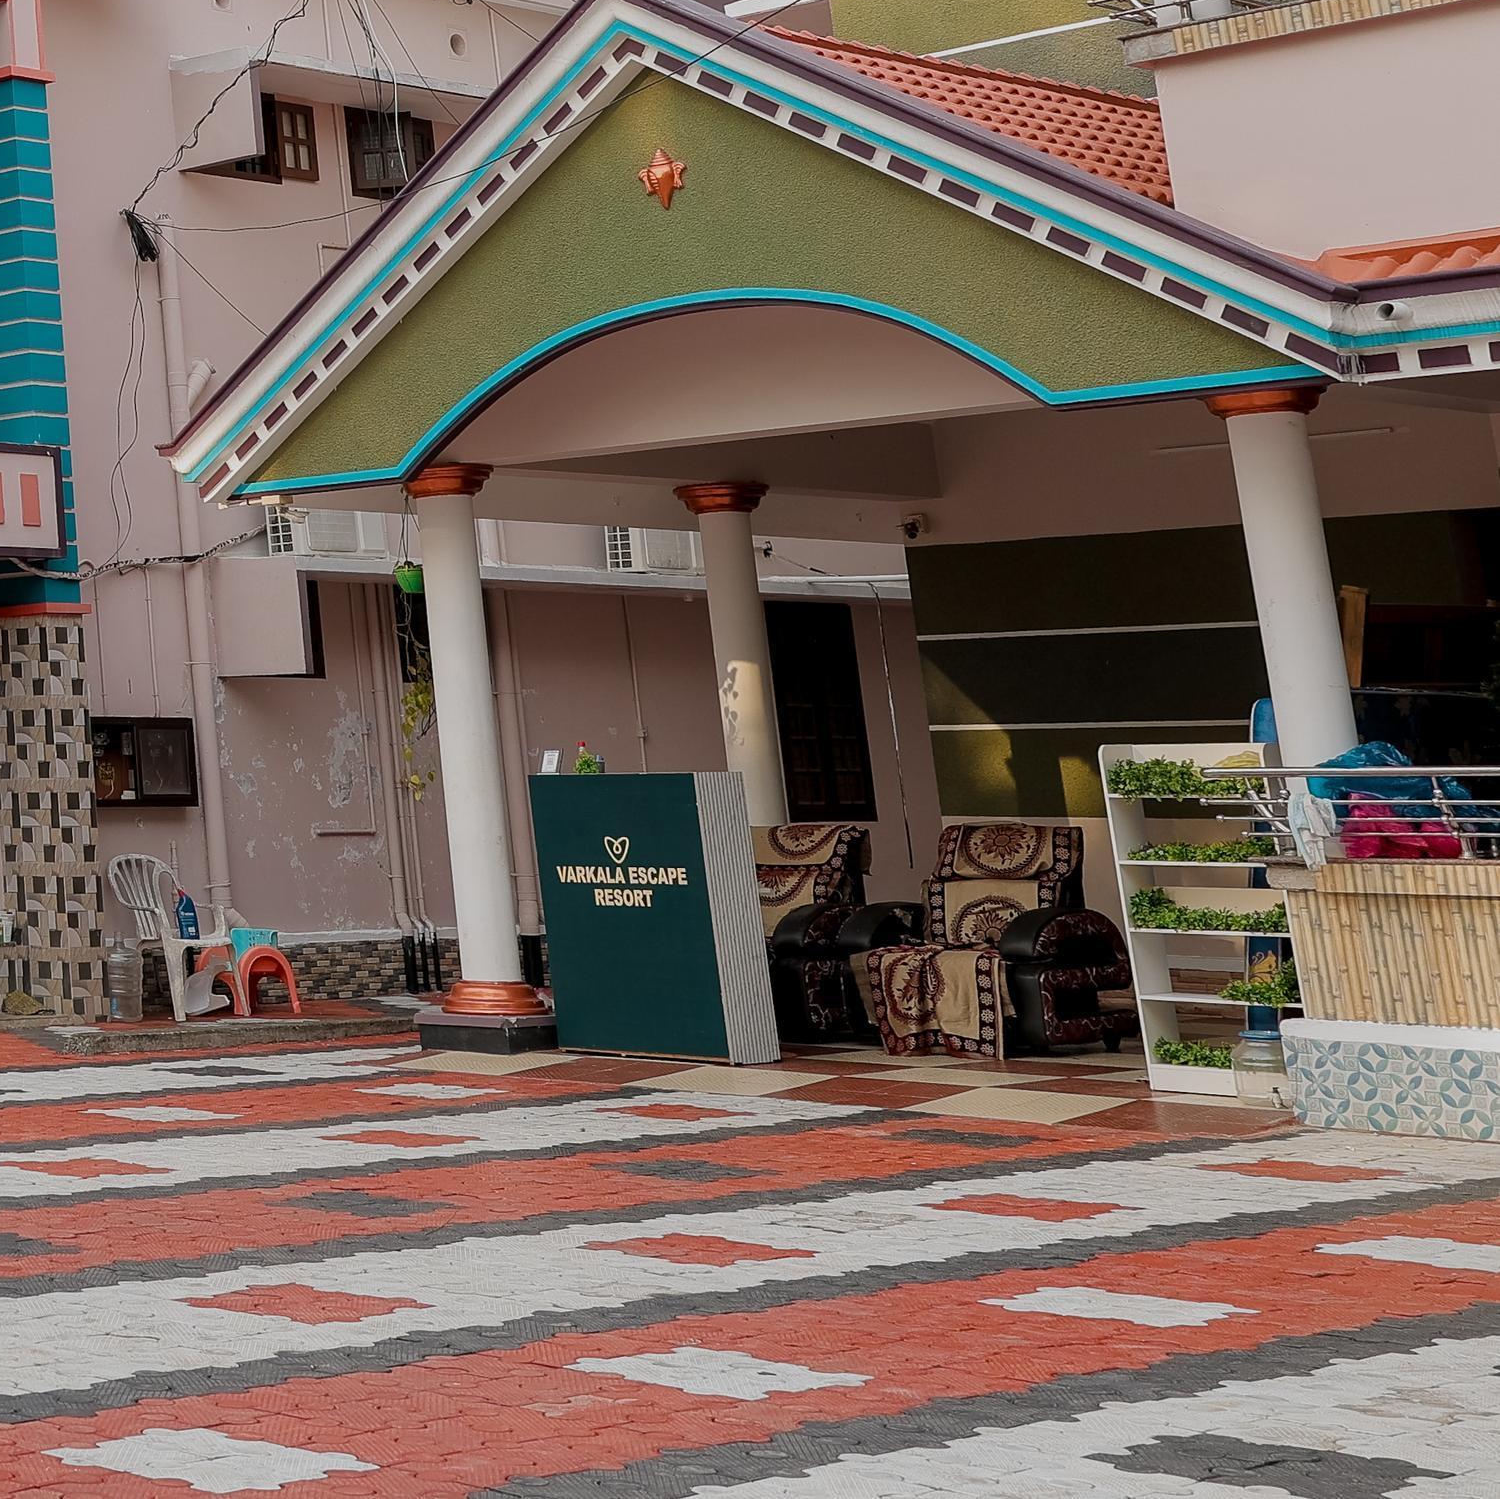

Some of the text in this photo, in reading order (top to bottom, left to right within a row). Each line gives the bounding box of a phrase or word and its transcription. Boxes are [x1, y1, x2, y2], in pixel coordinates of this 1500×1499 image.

[556, 866, 688, 885] VARKALA ESCAPE
[594, 888, 653, 907] RESORT
